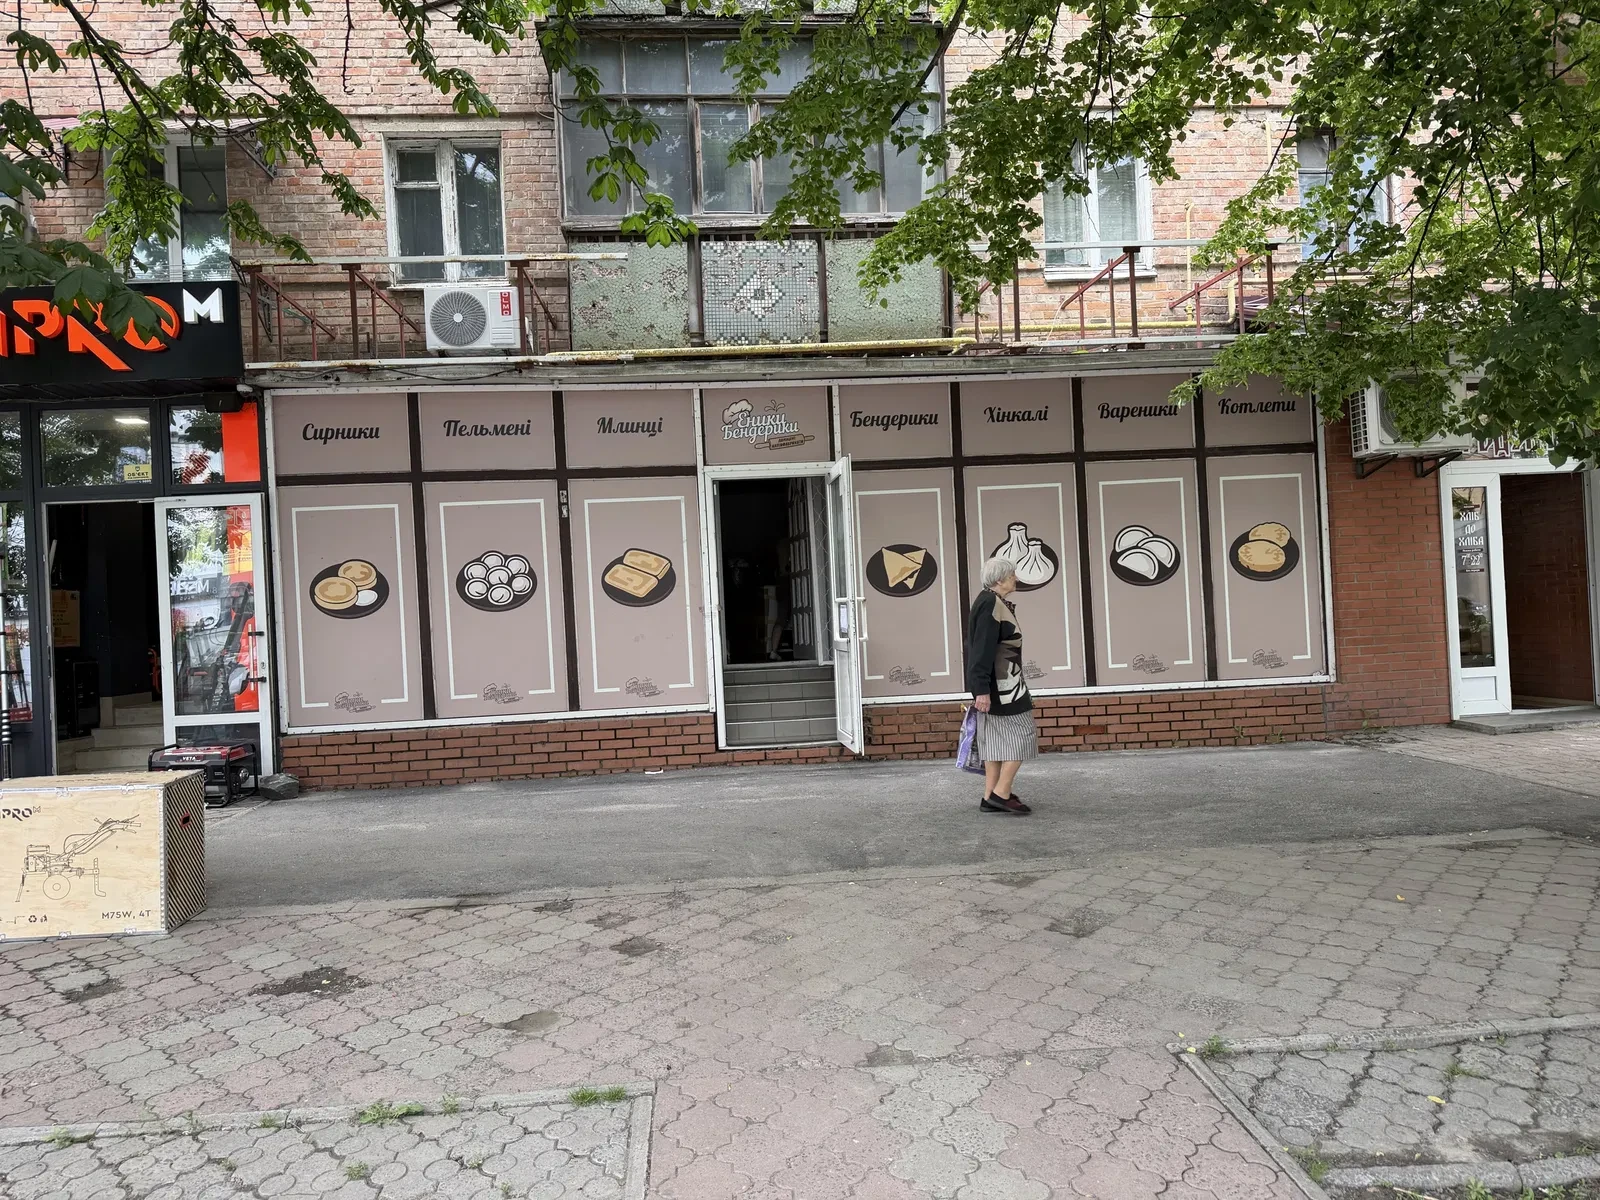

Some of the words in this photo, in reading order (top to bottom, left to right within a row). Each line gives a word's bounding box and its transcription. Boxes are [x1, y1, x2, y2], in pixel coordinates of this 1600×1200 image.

[182, 287, 224, 324] M
[983, 405, 1049, 424] Хінкалі
[1097, 402, 1178, 423] Вареники
[1217, 398, 1296, 416] Котлети
[443, 419, 532, 438] Пельмені
[597, 416, 663, 438] Млинці
[849, 411, 939, 431] Бендерики
[302, 423, 380, 445] Сирники
[721, 421, 799, 443] Бендерики
[1459, 511, 1480, 521] ХЛІБ
[1465, 524, 1476, 535] ДО
[1458, 536, 1484, 547] ХЛІБА
[101, 911, 137, 920] M75W,
[139, 909, 152, 918] 4T
